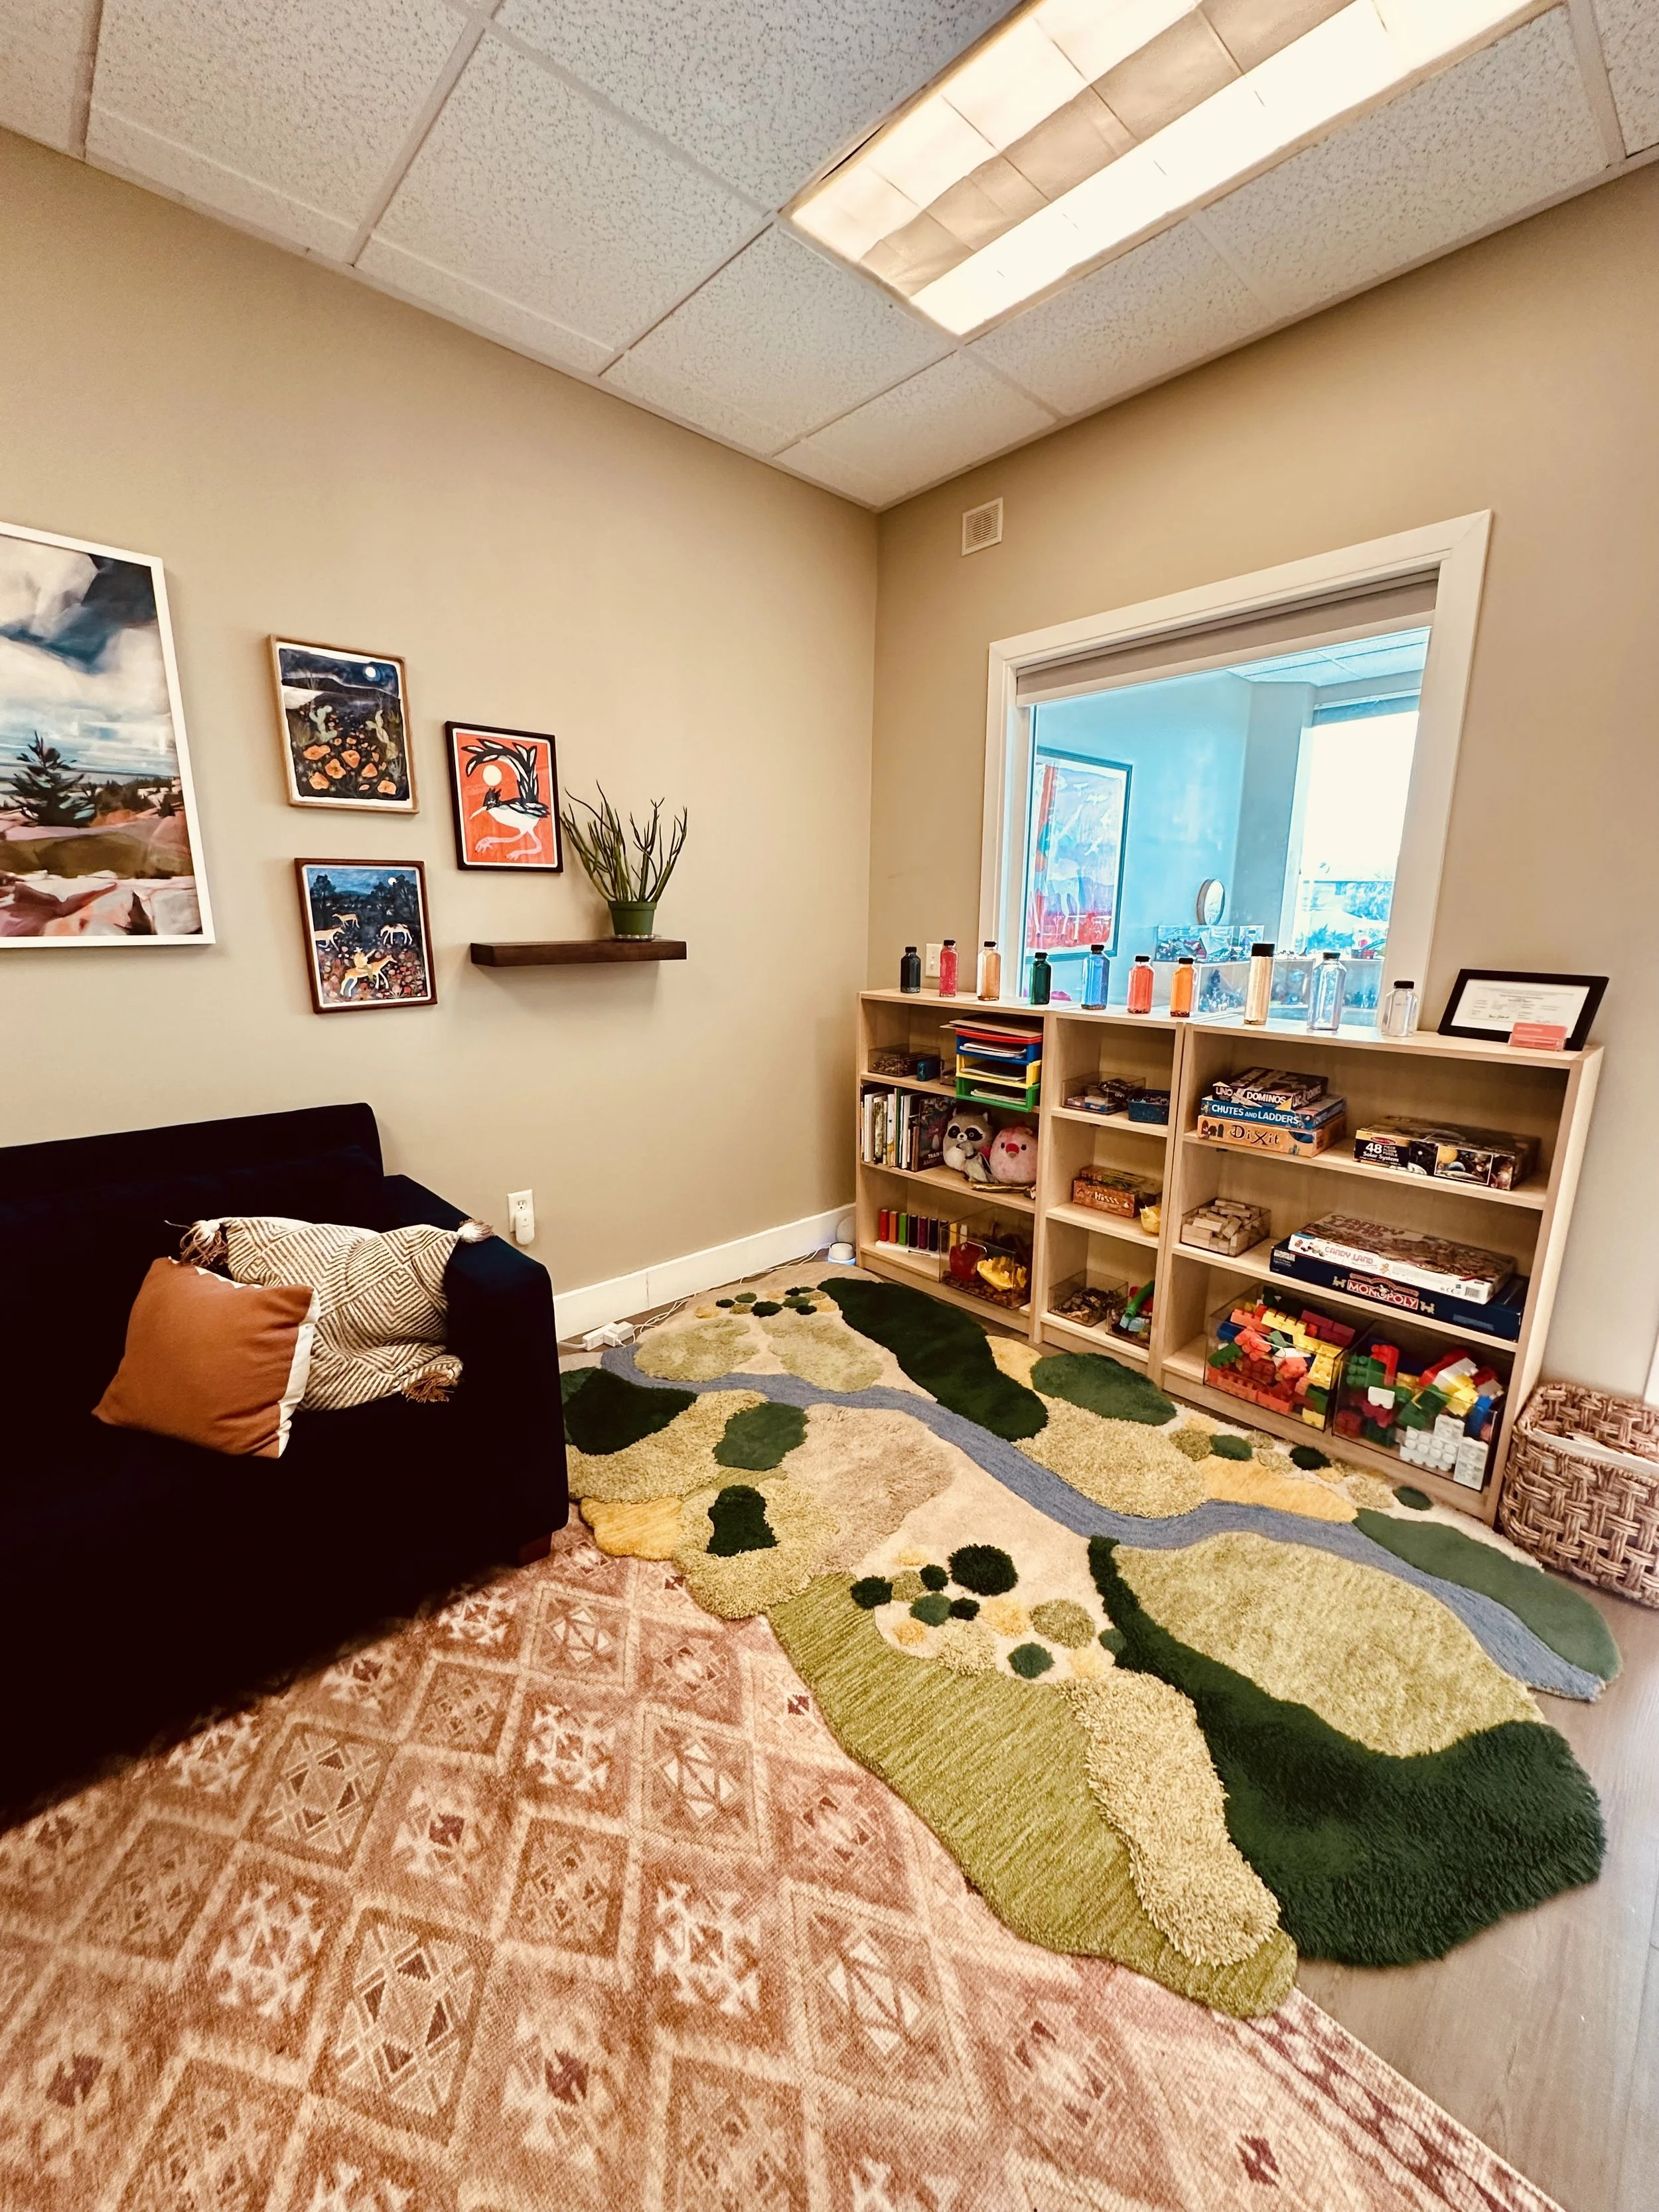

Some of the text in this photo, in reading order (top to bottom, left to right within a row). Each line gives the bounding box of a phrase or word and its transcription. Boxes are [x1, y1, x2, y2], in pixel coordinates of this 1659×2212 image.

[1216, 1086, 1286, 1104] UNO DOMINOS
[1211, 1104, 1244, 1116] CHUTES
[1258, 1111, 1299, 1124] LADDERS
[1365, 1142, 1383, 1154] 48
[1378, 1154, 1400, 1163] System
[1325, 1246, 1374, 1264] CANDY LAND
[1348, 1282, 1417, 1307] MONOPOLY
